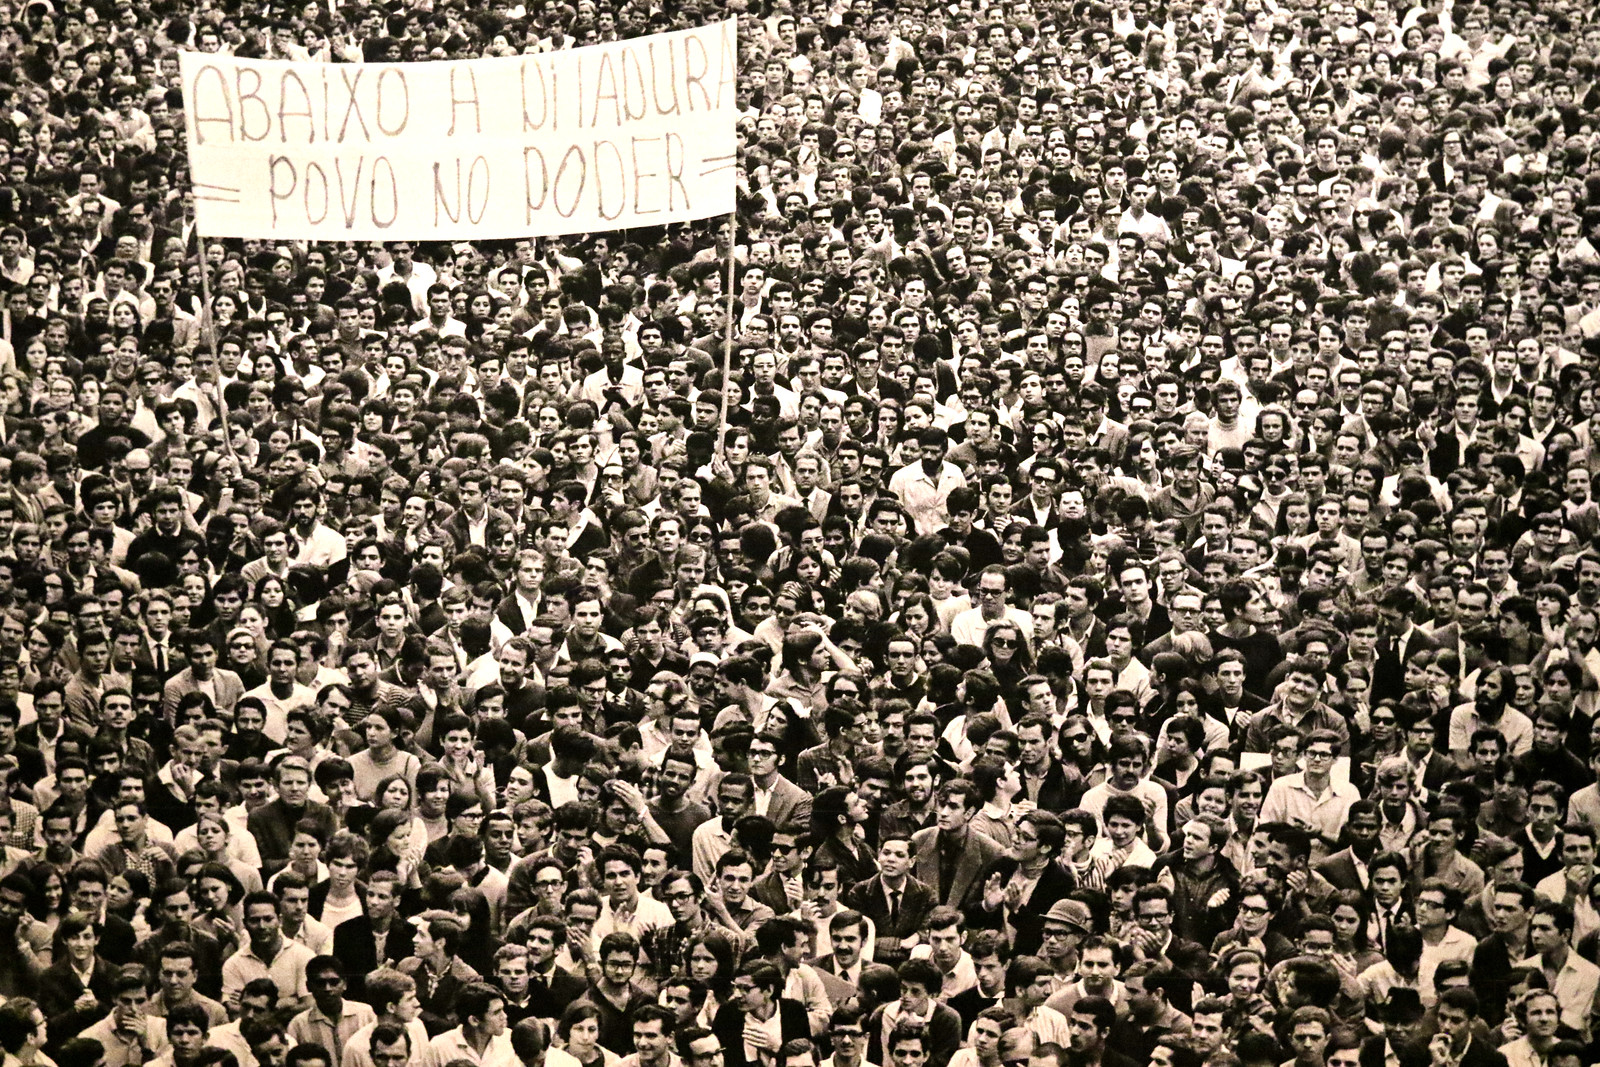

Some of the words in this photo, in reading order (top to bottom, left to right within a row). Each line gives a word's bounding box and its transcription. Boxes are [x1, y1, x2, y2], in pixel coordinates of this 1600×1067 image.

[269, 154, 398, 229] POVO
[432, 155, 490, 228] NO
[523, 132, 690, 226] PODER
